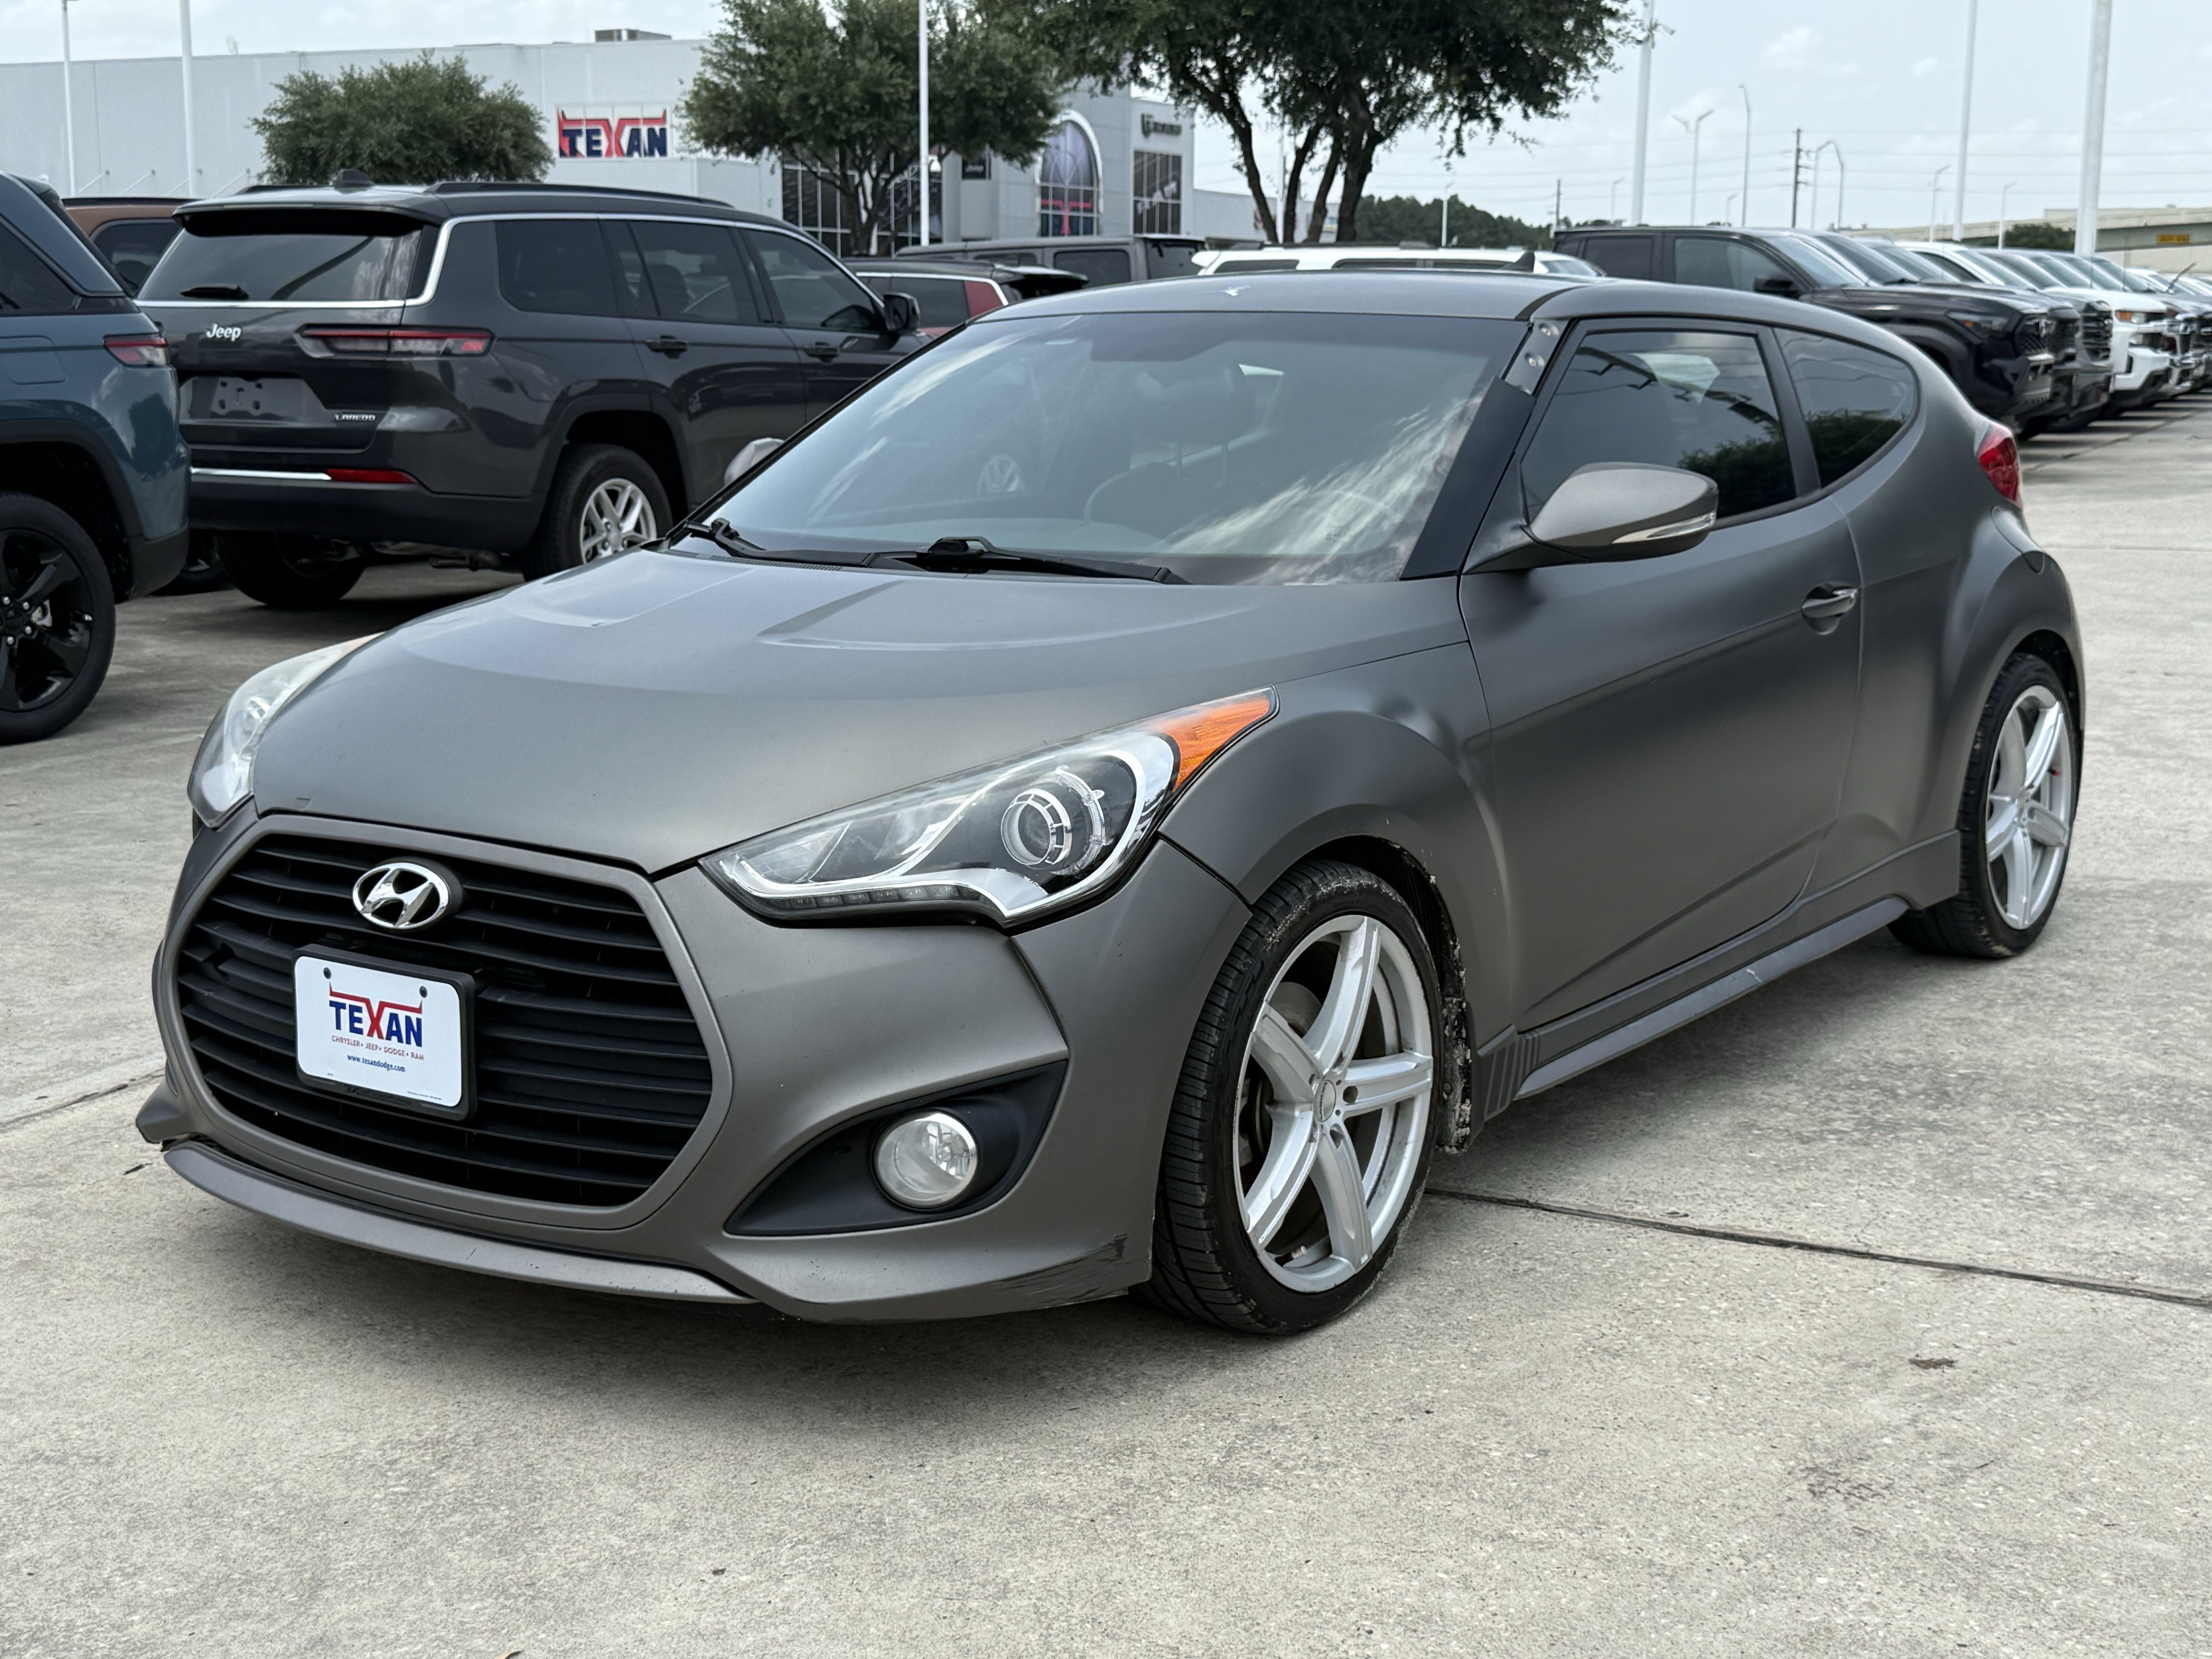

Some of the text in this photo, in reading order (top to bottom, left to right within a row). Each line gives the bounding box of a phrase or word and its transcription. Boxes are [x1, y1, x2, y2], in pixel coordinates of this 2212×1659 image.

[558, 110, 666, 158] TEXAN
[206, 323, 241, 342] Jeep
[329, 986, 422, 1047] TEXAN
[331, 1035, 424, 1060] CHRYSLER JEEP DODGE RAM
[347, 1054, 405, 1072] www.texandodge.com
